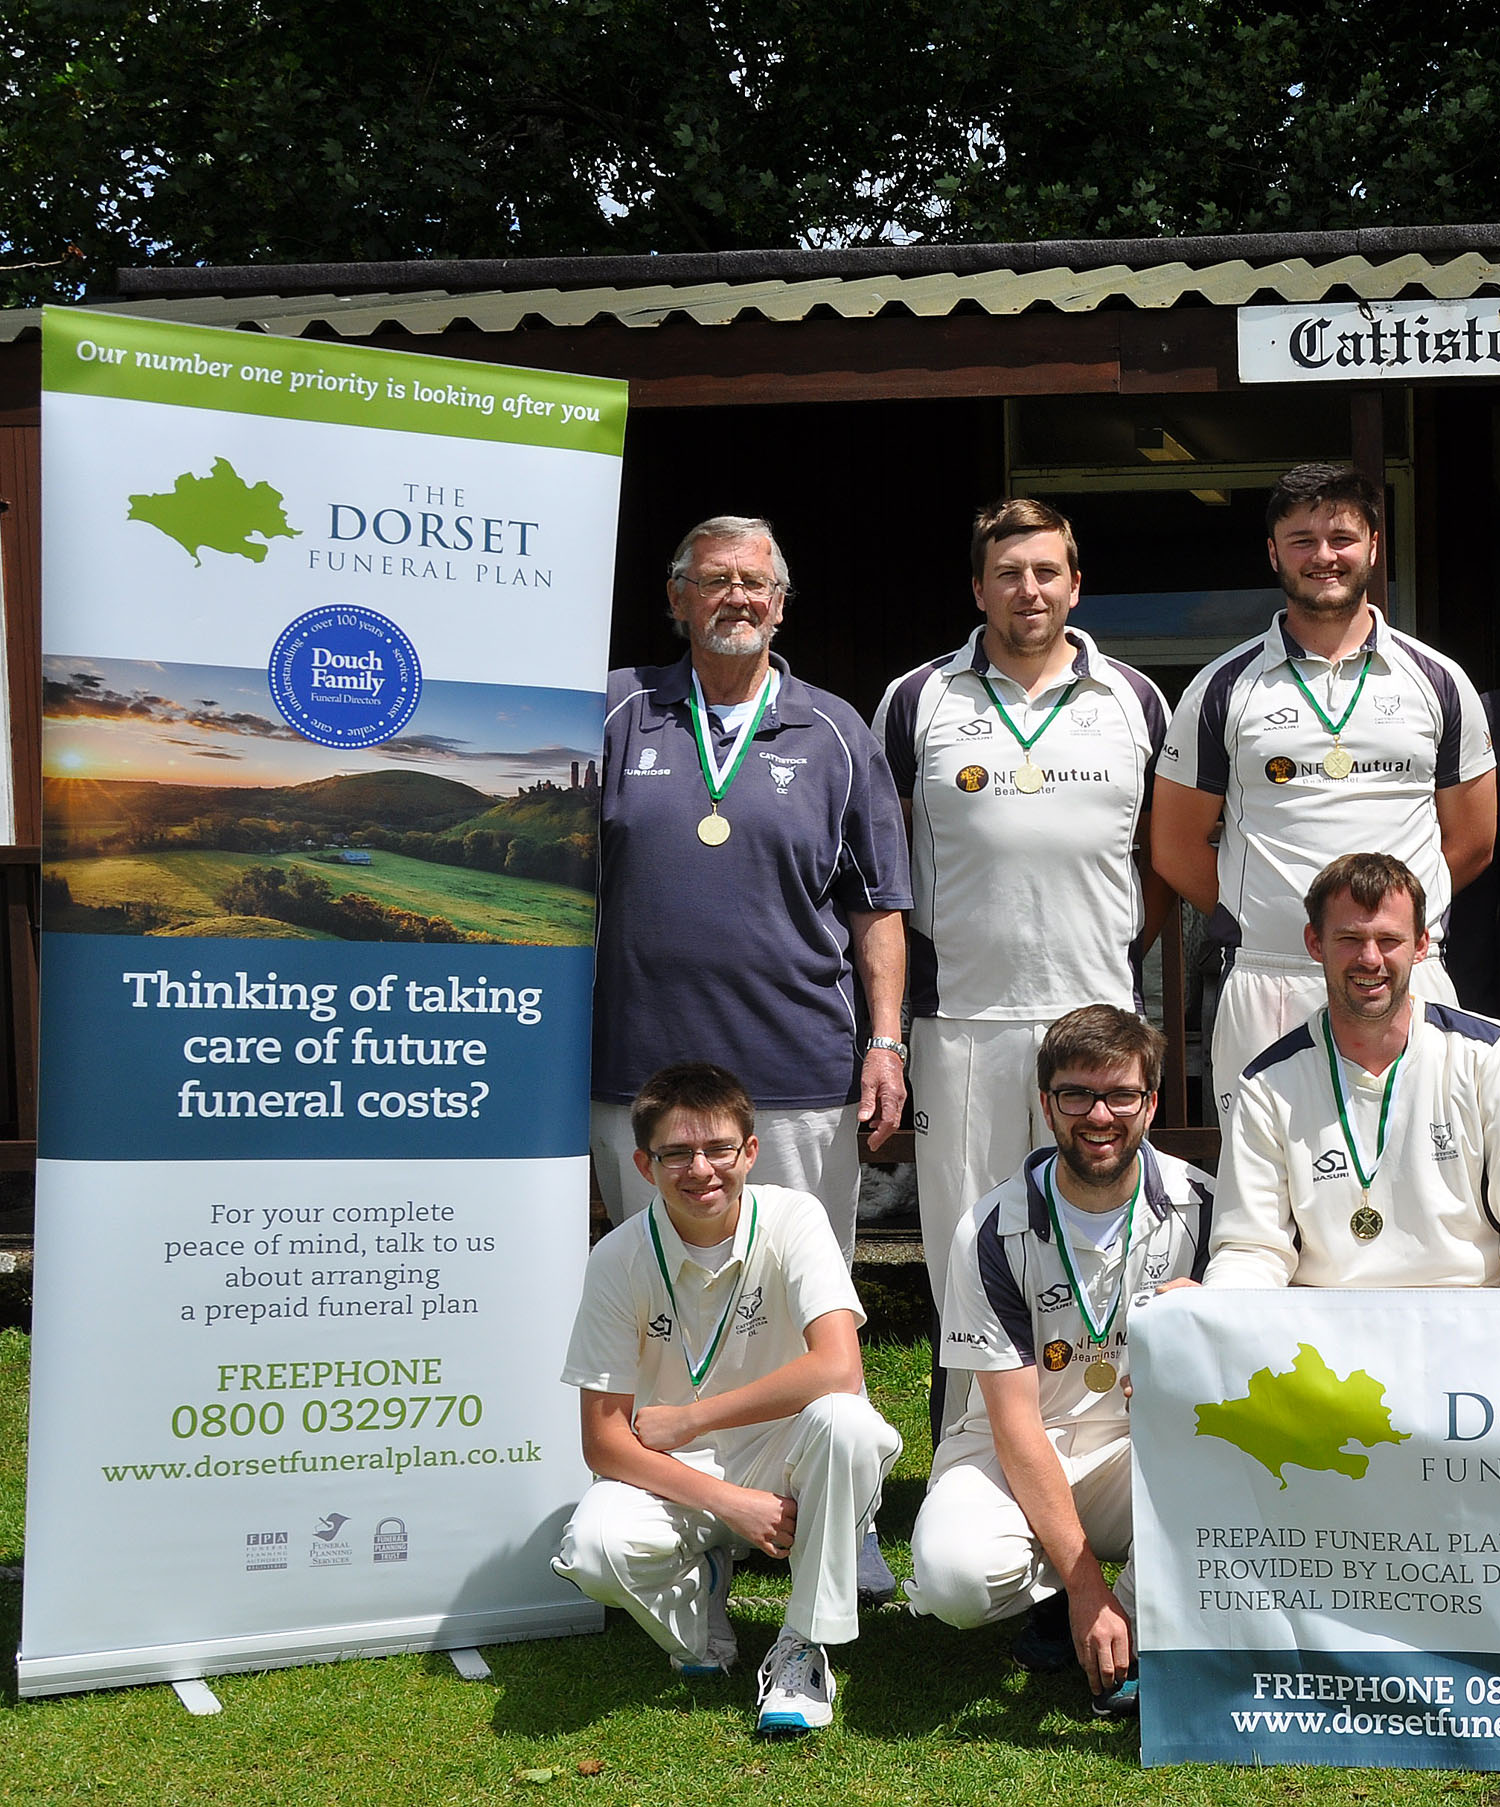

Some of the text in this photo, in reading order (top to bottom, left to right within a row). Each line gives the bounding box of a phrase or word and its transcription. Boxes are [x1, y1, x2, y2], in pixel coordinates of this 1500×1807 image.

[75, 338, 601, 424] Our number one priority is looking after you
[404, 483, 466, 508] THE
[328, 502, 540, 557] DORSET
[308, 549, 554, 589] FUNERAL PLAN
[311, 615, 384, 638] over 100 years
[311, 647, 384, 671] Douch
[393, 648, 410, 683] service
[282, 637, 304, 712] understanding
[311, 668, 386, 697] Family
[311, 693, 381, 705] Funeral Directors
[387, 696, 405, 719] trust
[311, 718, 333, 733] care
[347, 724, 376, 738] value
[759, 751, 808, 765] CATTISTOCK
[1042, 769, 1110, 782] Mutual
[122, 970, 543, 1025] Thinking of taking
[183, 1026, 487, 1067] care of future
[177, 1079, 490, 1120] funeral costs?
[1313, 1172, 1349, 1183] MASURI
[210, 1202, 455, 1229] For your complete
[164, 1233, 496, 1263] peace of mind, talk to us
[225, 1263, 440, 1290] about arranging
[180, 1294, 479, 1325] a prepaid funeral plan
[217, 1358, 442, 1391] FREEPHONE
[171, 1394, 483, 1439] 0800 0329770
[101, 1441, 542, 1483] www.dorsetfuneralplan.co.uk
[247, 1532, 288, 1545] FPA
[313, 1542, 350, 1550] FUNERAL
[1196, 1527, 1307, 1551] PREPAID
[1314, 1529, 1440, 1553] FUNERAL
[309, 1549, 352, 1557] PLANNING
[1197, 1558, 1336, 1580] PROVIDED
[1341, 1560, 1375, 1581] BY
[1385, 1561, 1475, 1584] LOCAL
[1198, 1589, 1483, 1615] FUNERAL DIRECTORS
[1252, 1672, 1455, 1705] FREEPHONE
